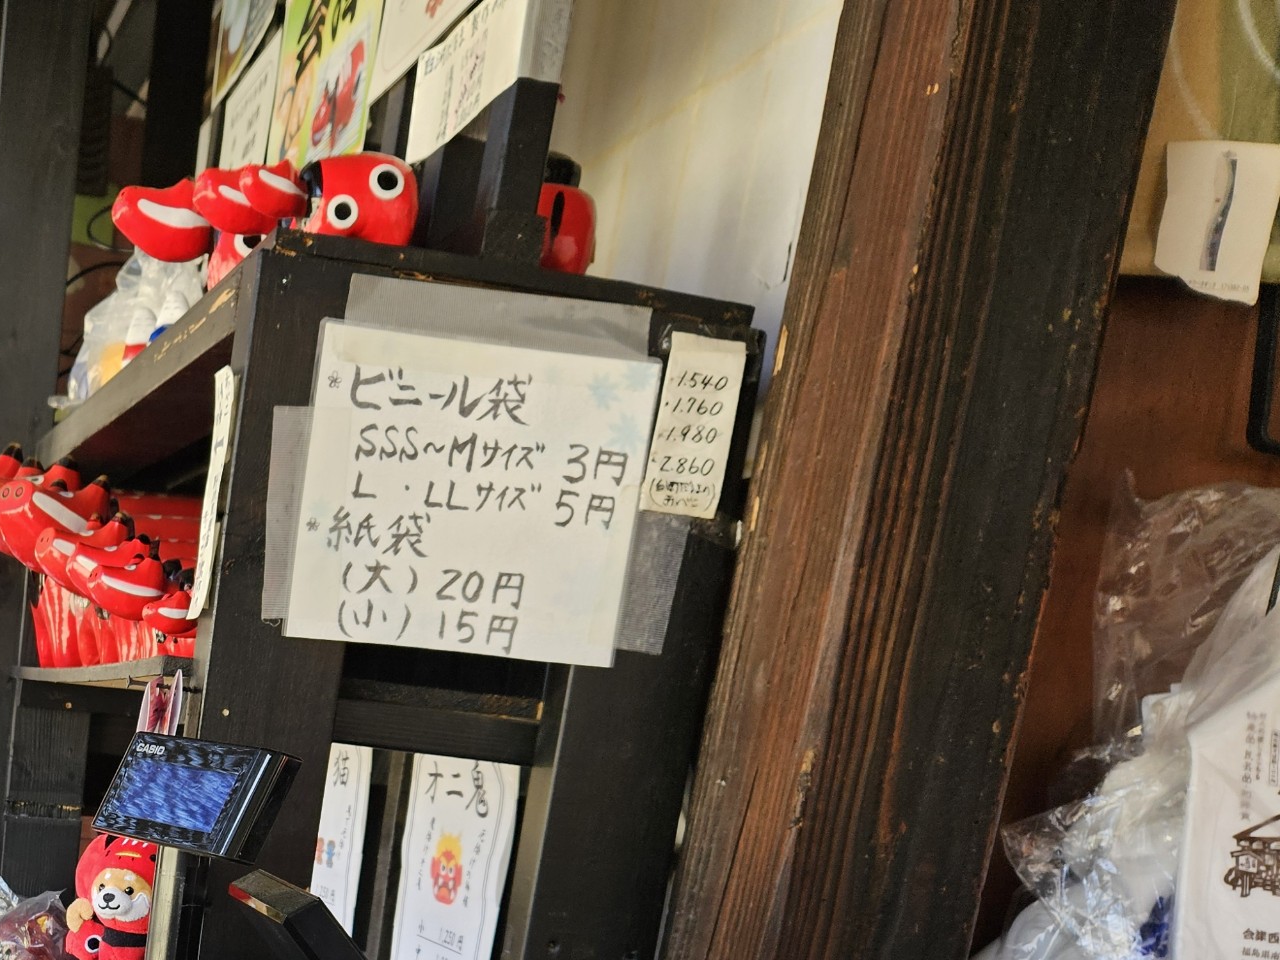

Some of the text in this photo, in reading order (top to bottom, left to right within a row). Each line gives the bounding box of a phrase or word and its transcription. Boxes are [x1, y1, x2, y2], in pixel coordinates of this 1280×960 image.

[350, 365, 532, 425] ビニール袋
[563, 444, 627, 487] 3円
[326, 507, 431, 557] 紙袋
[556, 494, 615, 529] 5円
[136, 743, 165, 755] CASIO
